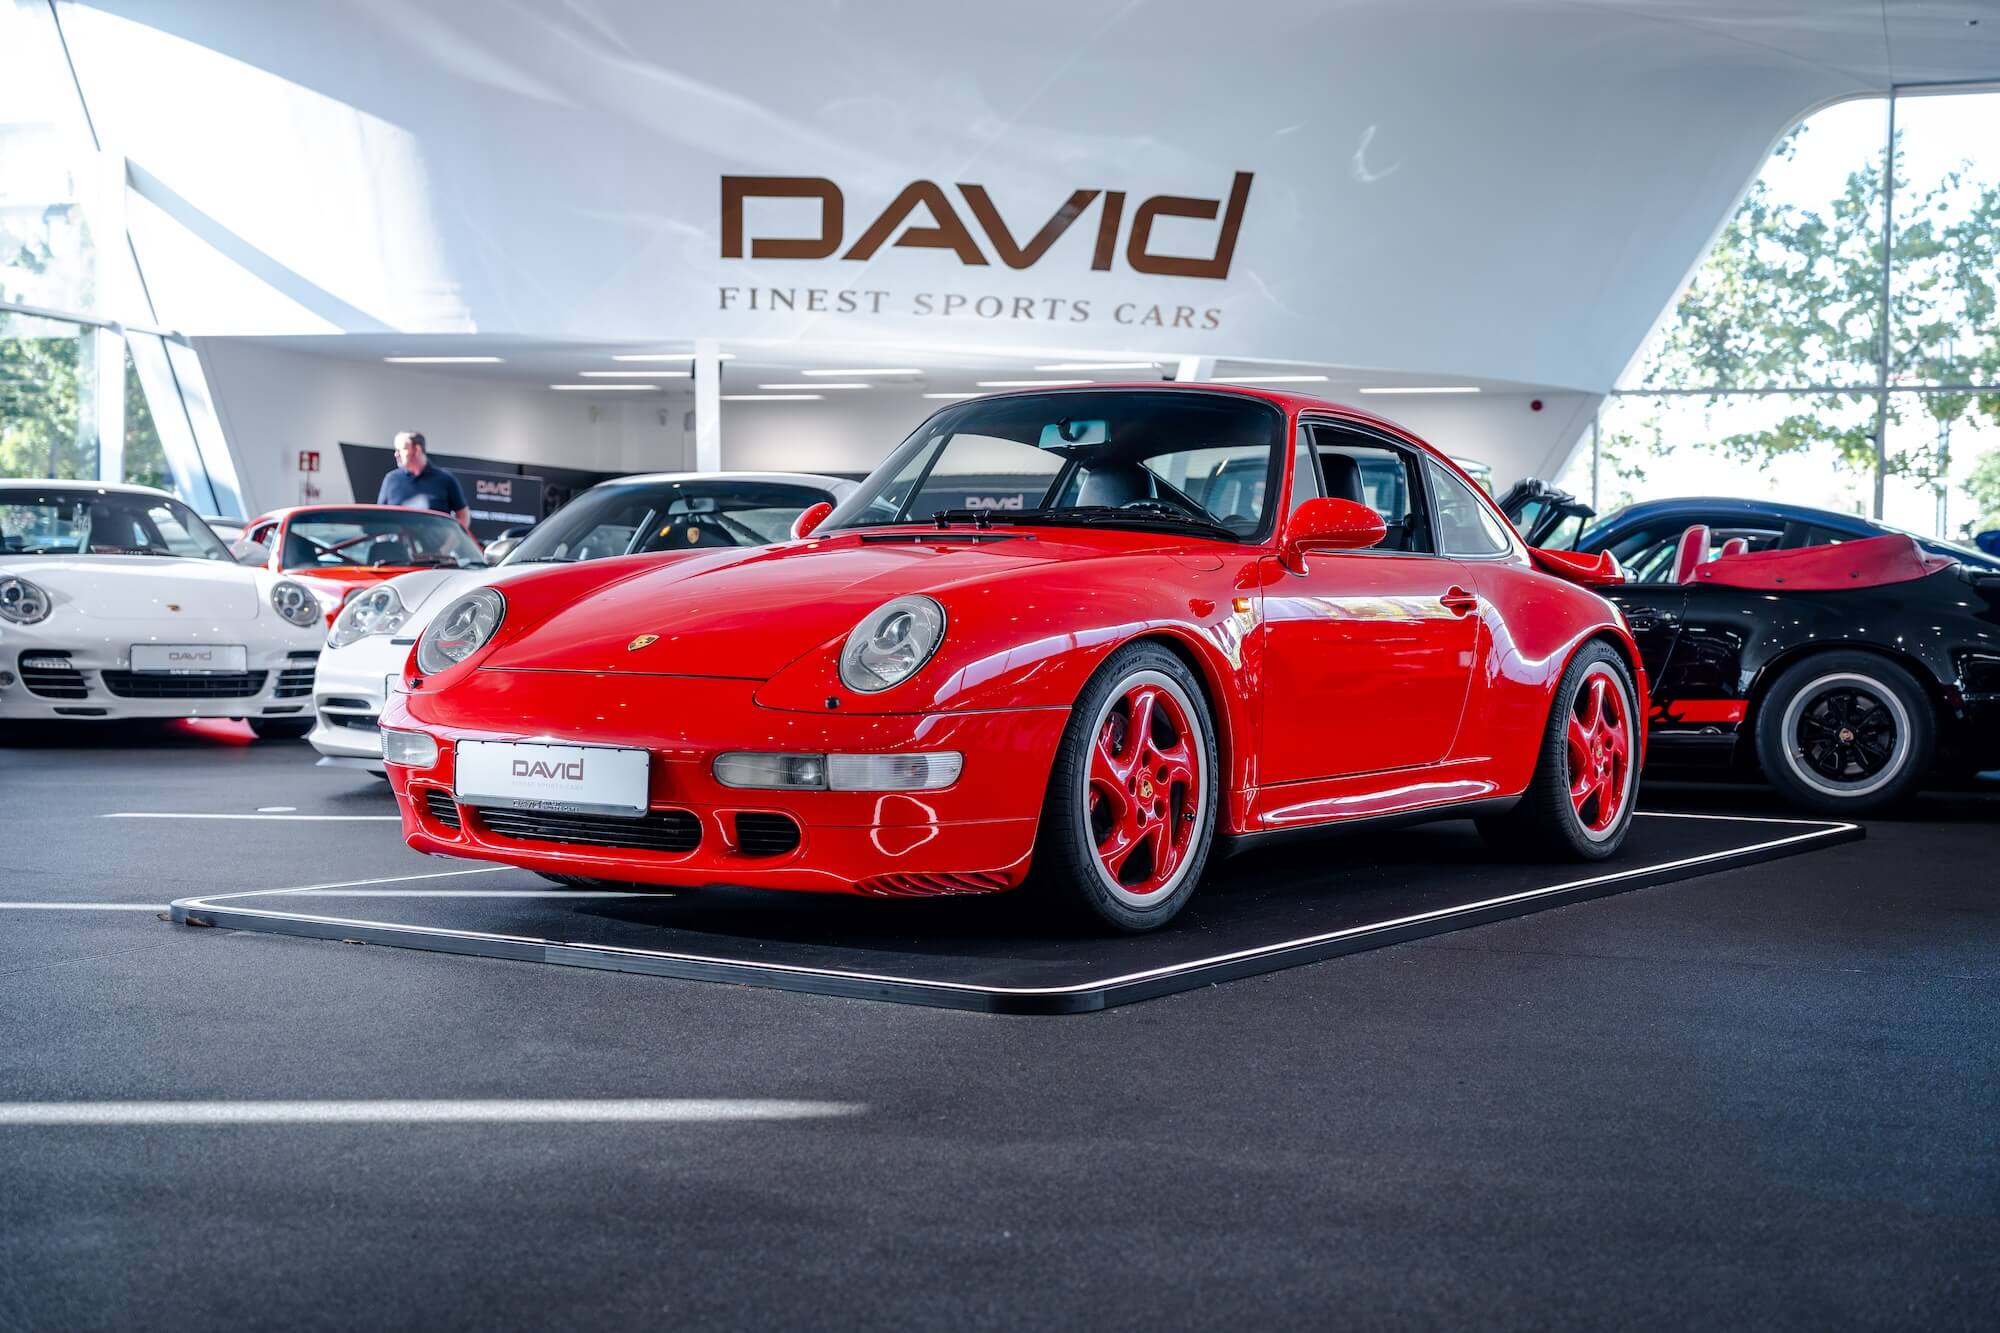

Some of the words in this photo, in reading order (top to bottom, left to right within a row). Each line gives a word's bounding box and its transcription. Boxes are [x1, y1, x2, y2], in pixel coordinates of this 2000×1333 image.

[718, 287, 890, 314] FINEST
[913, 292, 1091, 323] SPORTS
[1113, 303, 1222, 330] CARS
